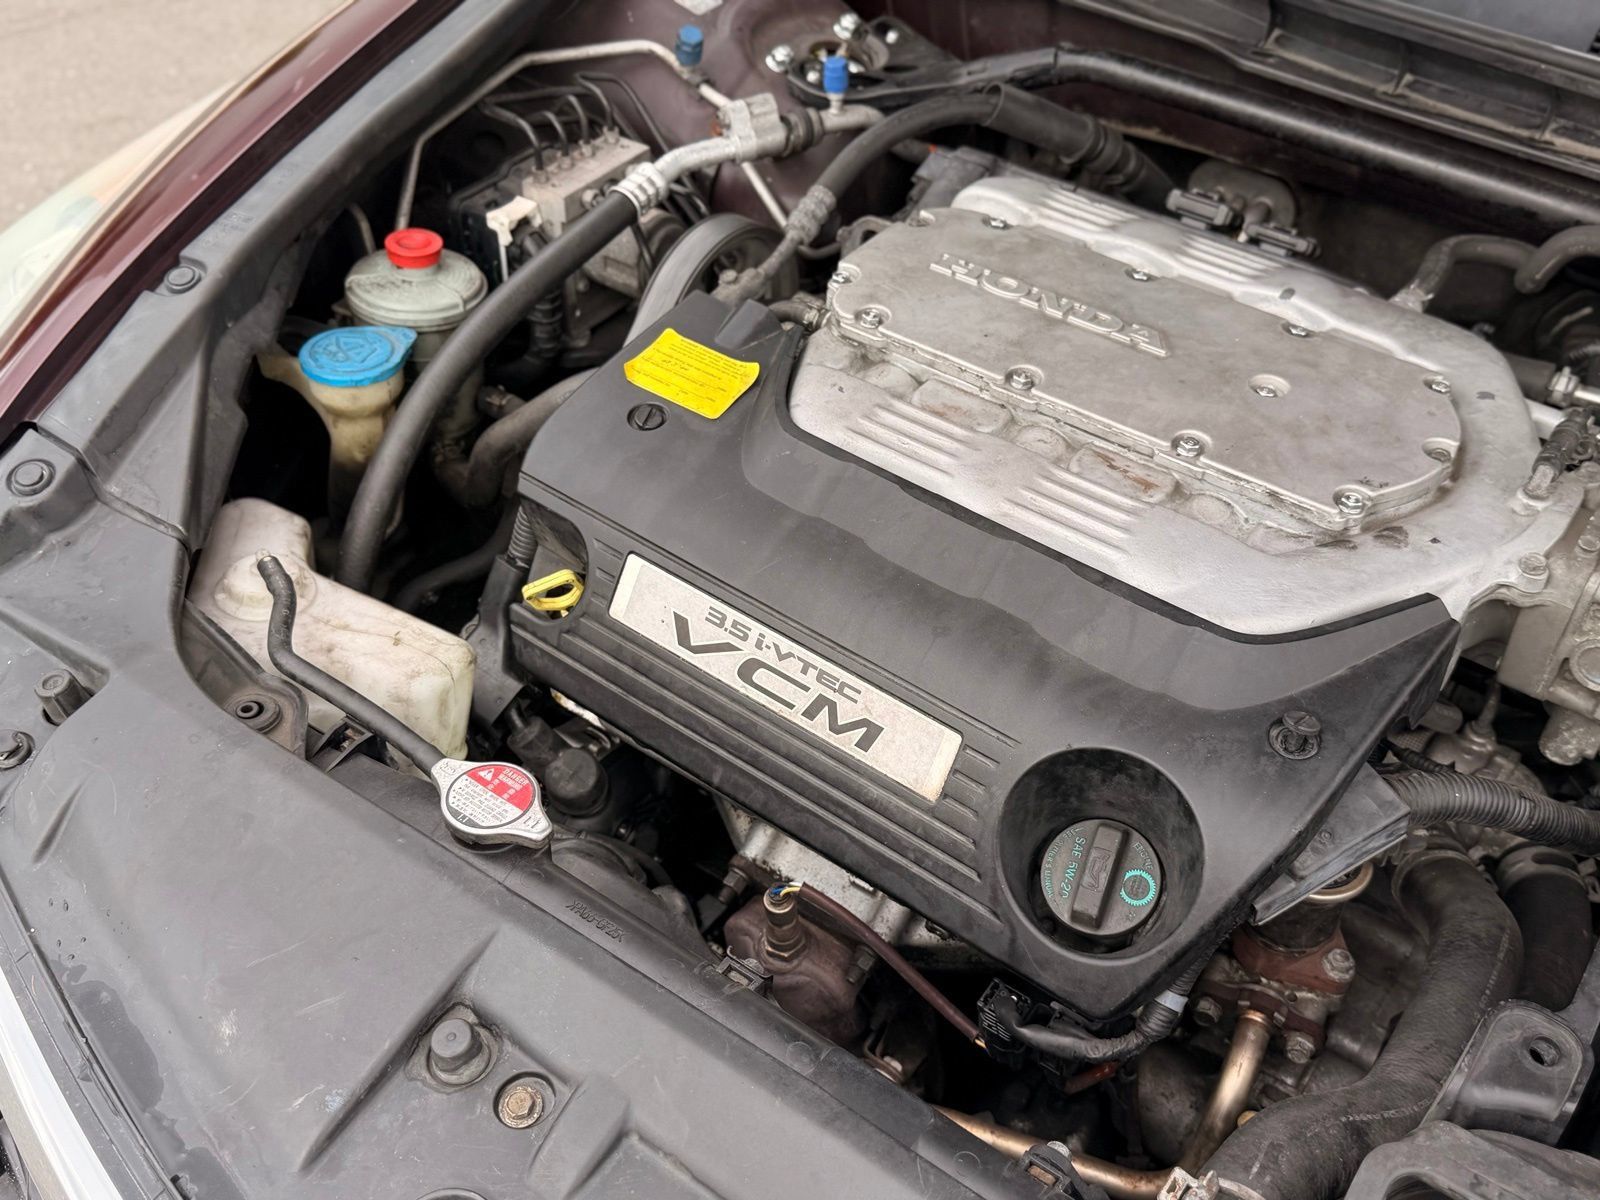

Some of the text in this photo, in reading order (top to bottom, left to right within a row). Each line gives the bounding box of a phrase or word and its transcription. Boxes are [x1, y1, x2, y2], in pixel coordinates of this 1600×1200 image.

[929, 252, 1170, 358] HONDA
[672, 610, 885, 753] VCM
[704, 605, 862, 705] 3.5 i-VTEC
[502, 767, 530, 786] DANGER
[1071, 836, 1086, 859] SAE
